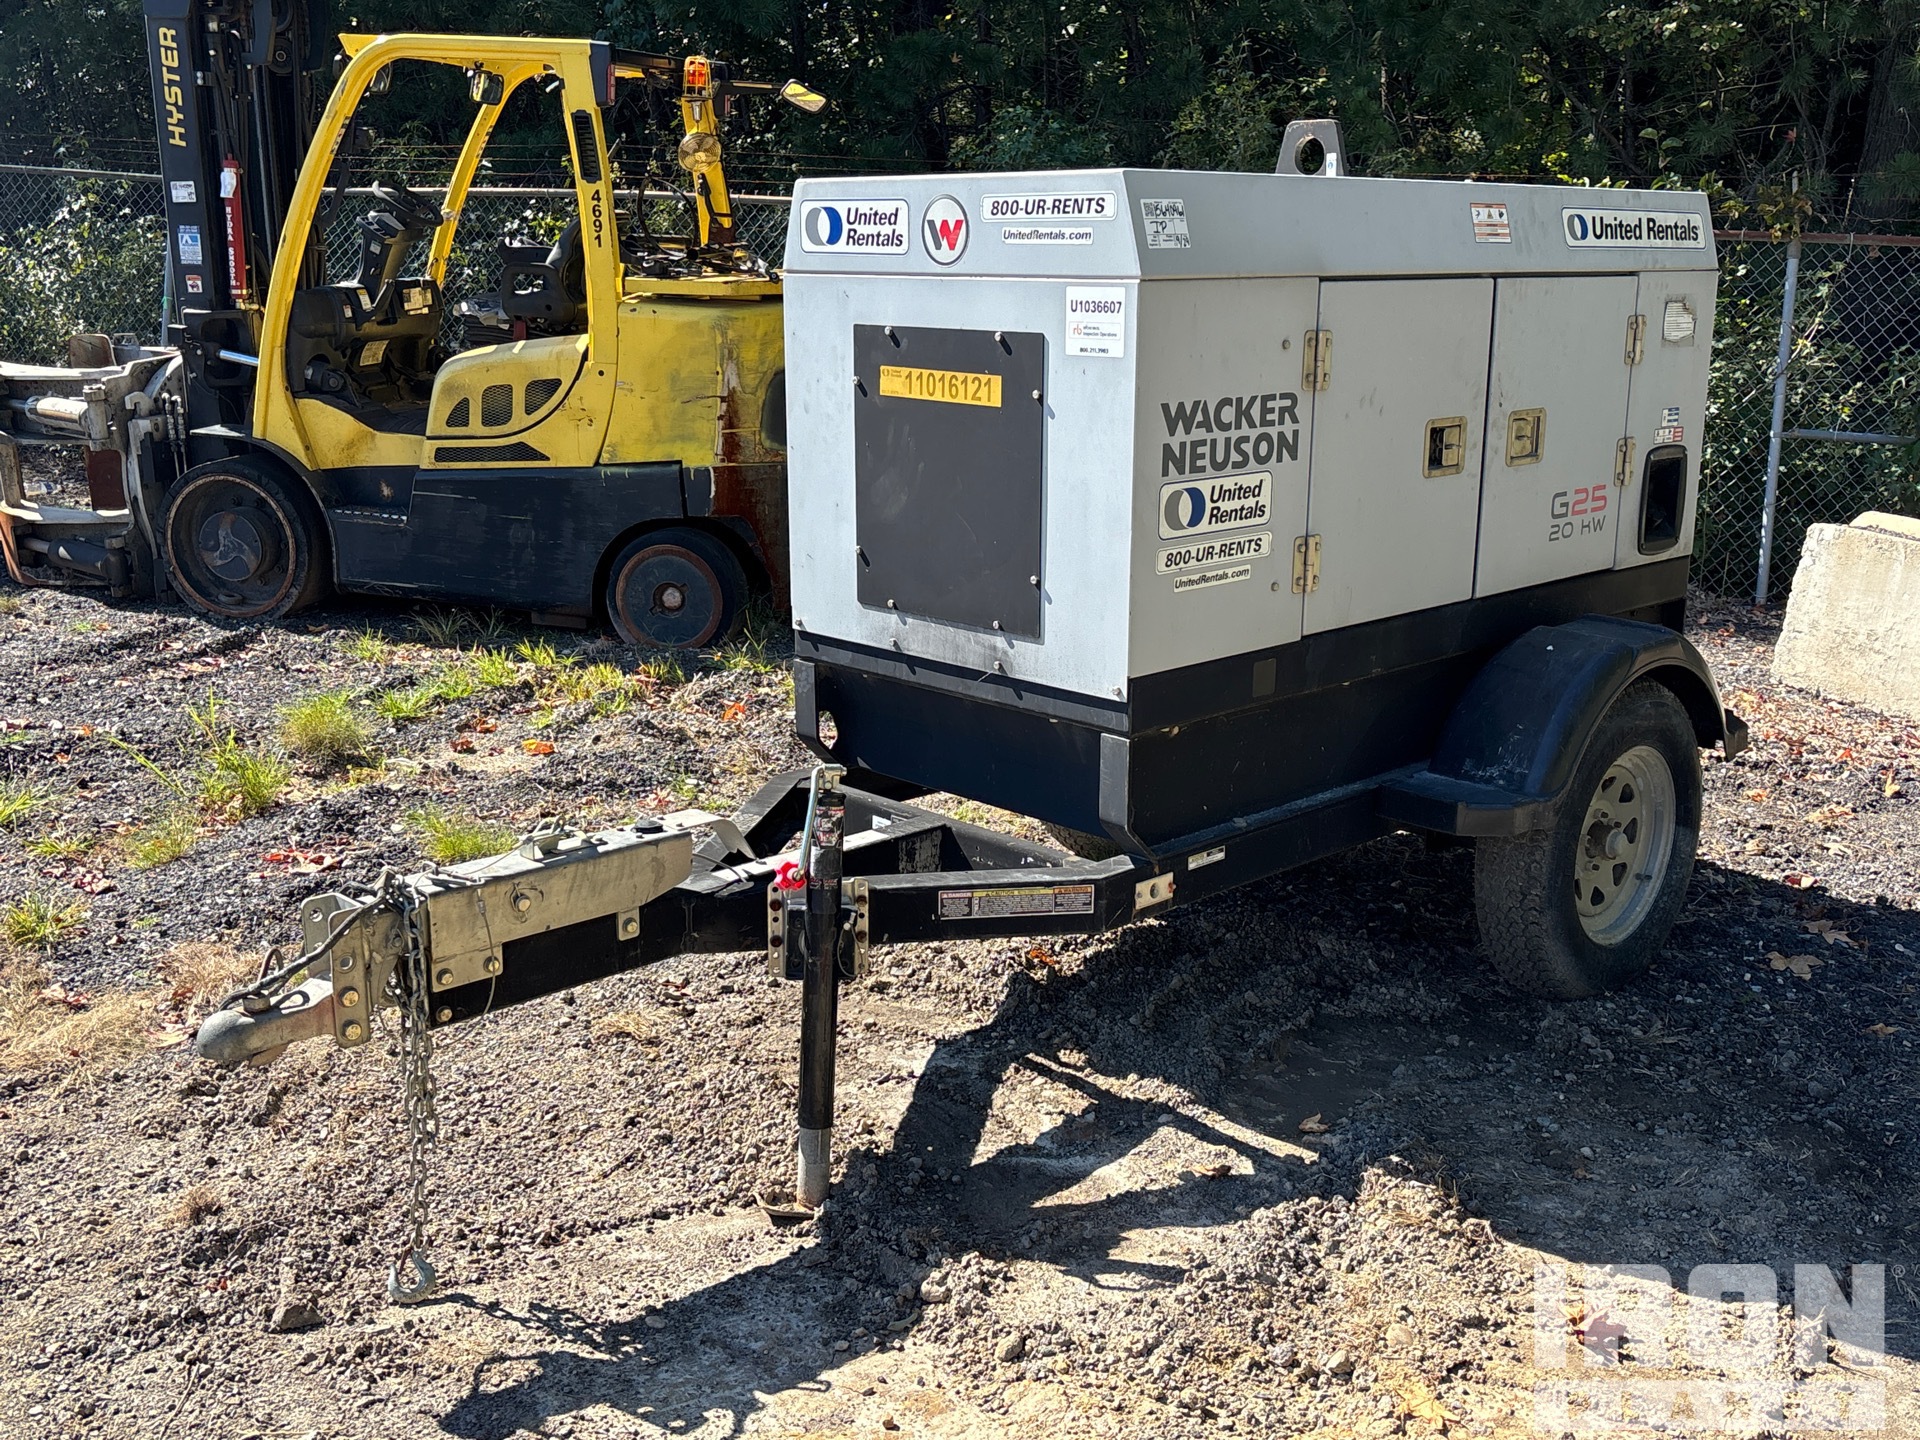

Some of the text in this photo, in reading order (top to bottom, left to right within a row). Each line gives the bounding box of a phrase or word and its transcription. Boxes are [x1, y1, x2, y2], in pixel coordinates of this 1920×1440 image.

[159, 27, 187, 147] HYSTER
[591, 189, 603, 248] 4691
[846, 207, 899, 226] United
[990, 197, 1106, 216] 800-UR-RENTS
[845, 228, 904, 248] Rentals
[926, 219, 964, 251] W
[1003, 229, 1092, 240] UnitedRentals.com
[1591, 216, 1699, 242] United Rentals
[1070, 299, 1122, 314] U1036607
[905, 370, 992, 403] 11016121
[1160, 392, 1300, 437] WACKER
[1161, 428, 1300, 478] NEUSON
[1209, 479, 1264, 504] United
[1551, 484, 1608, 520] G25
[1208, 502, 1267, 526] Rentals
[1549, 521, 1574, 542] 20
[1164, 537, 1263, 568] 800-UR-RENTS
[1174, 568, 1250, 590] UnitedRentals.com
